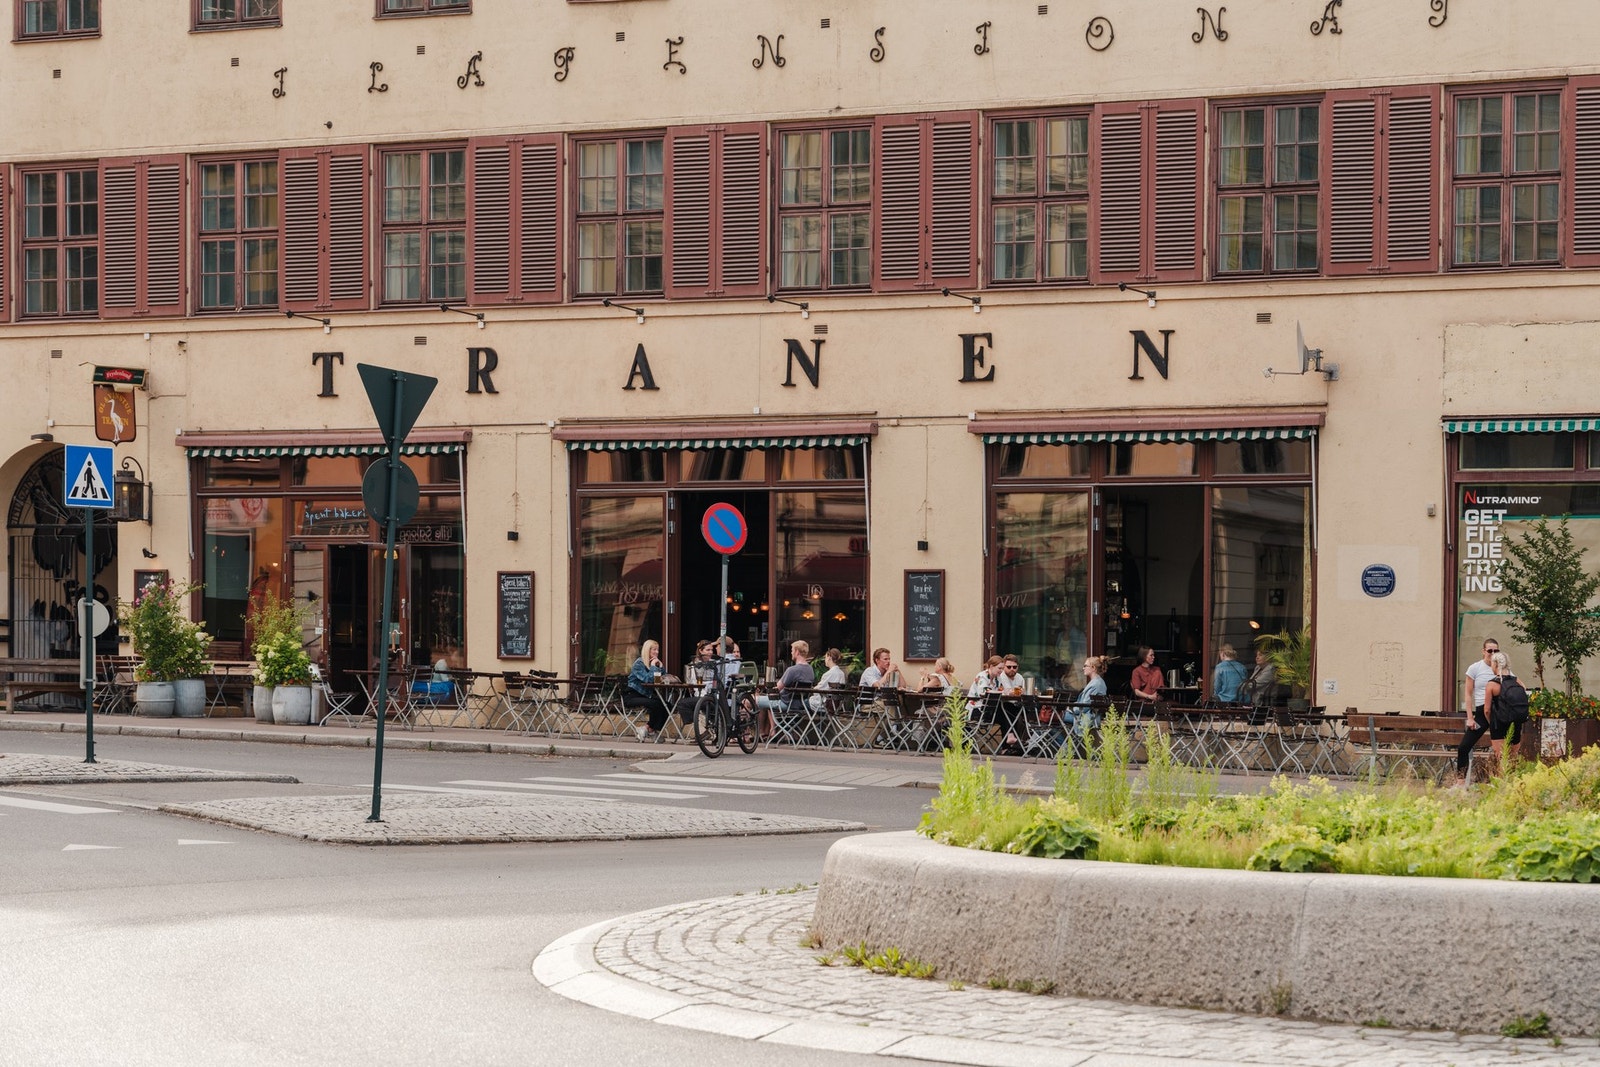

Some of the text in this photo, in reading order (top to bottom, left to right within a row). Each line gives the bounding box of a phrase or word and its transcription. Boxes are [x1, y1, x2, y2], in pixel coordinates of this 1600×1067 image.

[311, 329, 1176, 398] TRANEN
[1464, 509, 1508, 525] GET
[1465, 525, 1499, 542] FIT
[1467, 542, 1502, 558] DIE
[1462, 559, 1507, 575] TRY
[1465, 575, 1503, 592] ING
